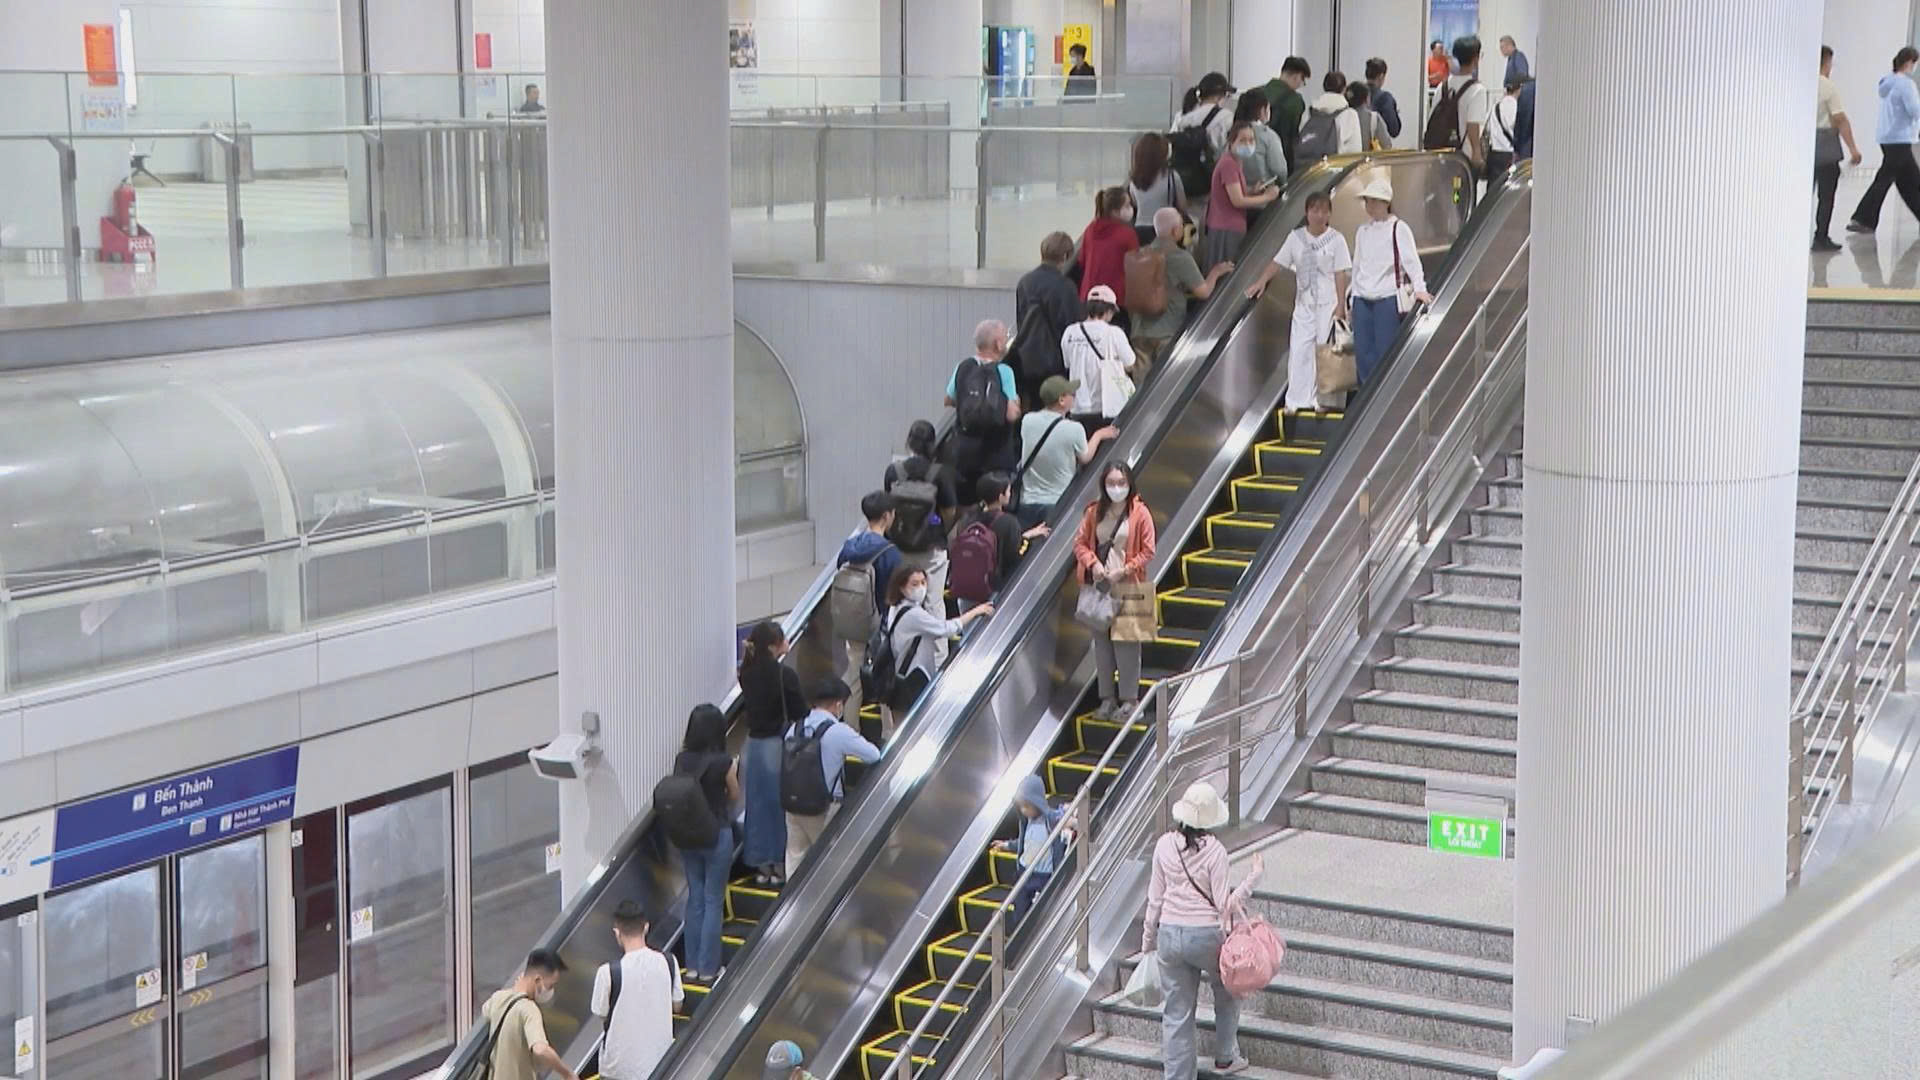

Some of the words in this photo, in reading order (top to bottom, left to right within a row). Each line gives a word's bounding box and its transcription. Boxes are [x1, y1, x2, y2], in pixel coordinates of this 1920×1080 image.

[154, 784, 177, 803] Bến
[179, 776, 213, 797] Thành
[161, 805, 178, 817] Ben
[179, 796, 203, 811] Thanh
[1442, 820, 1488, 841] EXIT
